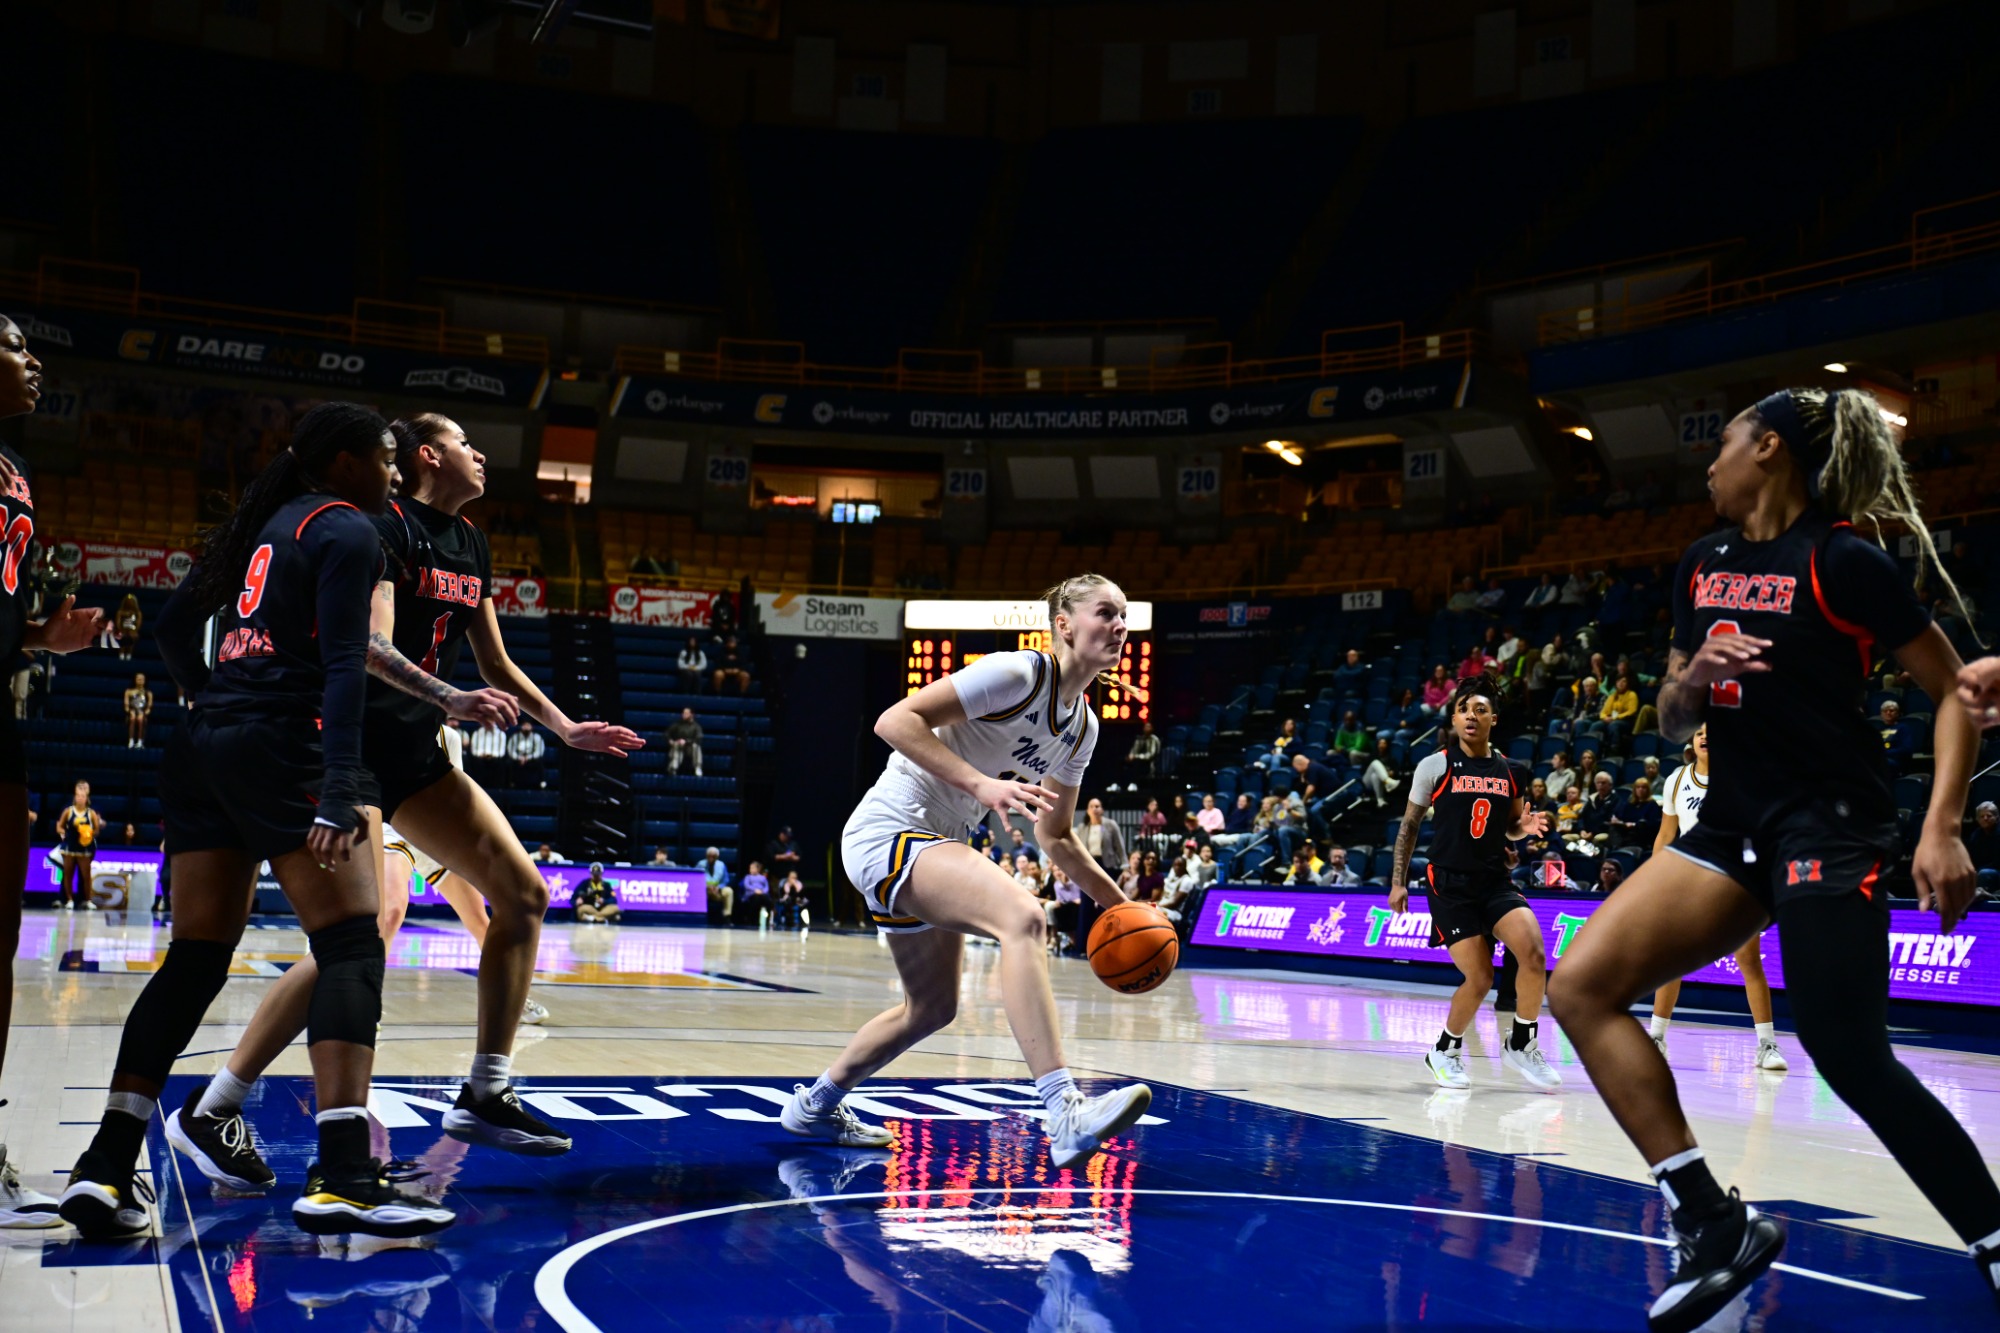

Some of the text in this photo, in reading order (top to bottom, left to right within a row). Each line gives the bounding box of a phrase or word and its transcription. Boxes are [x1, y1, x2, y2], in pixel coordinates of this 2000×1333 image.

[1539, 38, 1568, 62] 312
[855, 75, 883, 97] 310
[1191, 91, 1217, 113] 311
[175, 333, 366, 374] DARE AND DO
[909, 407, 1188, 429] OFFICIAL HEALTHCARE PARTNER
[1683, 413, 1720, 442] 212
[709, 458, 746, 481] 209
[1410, 453, 1437, 477] 211
[950, 471, 983, 493] 210
[1182, 470, 1215, 492] 210
[0, 504, 34, 596] 0
[236, 543, 273, 619] 9
[1350, 592, 1376, 608] 112
[1694, 571, 1797, 615] MERCER
[805, 598, 865, 616] Steam
[804, 615, 879, 635] Logistics
[420, 610, 454, 675] 1
[1451, 775, 1510, 798] MERCER
[1470, 798, 1492, 839] 8
[620, 879, 689, 897] LOTTERY
[622, 894, 687, 905] TENNESSEE
[1234, 904, 1296, 930] LOTTERY
[1388, 911, 1433, 937] LOTT
[1231, 926, 1286, 940] TENNESSEE
